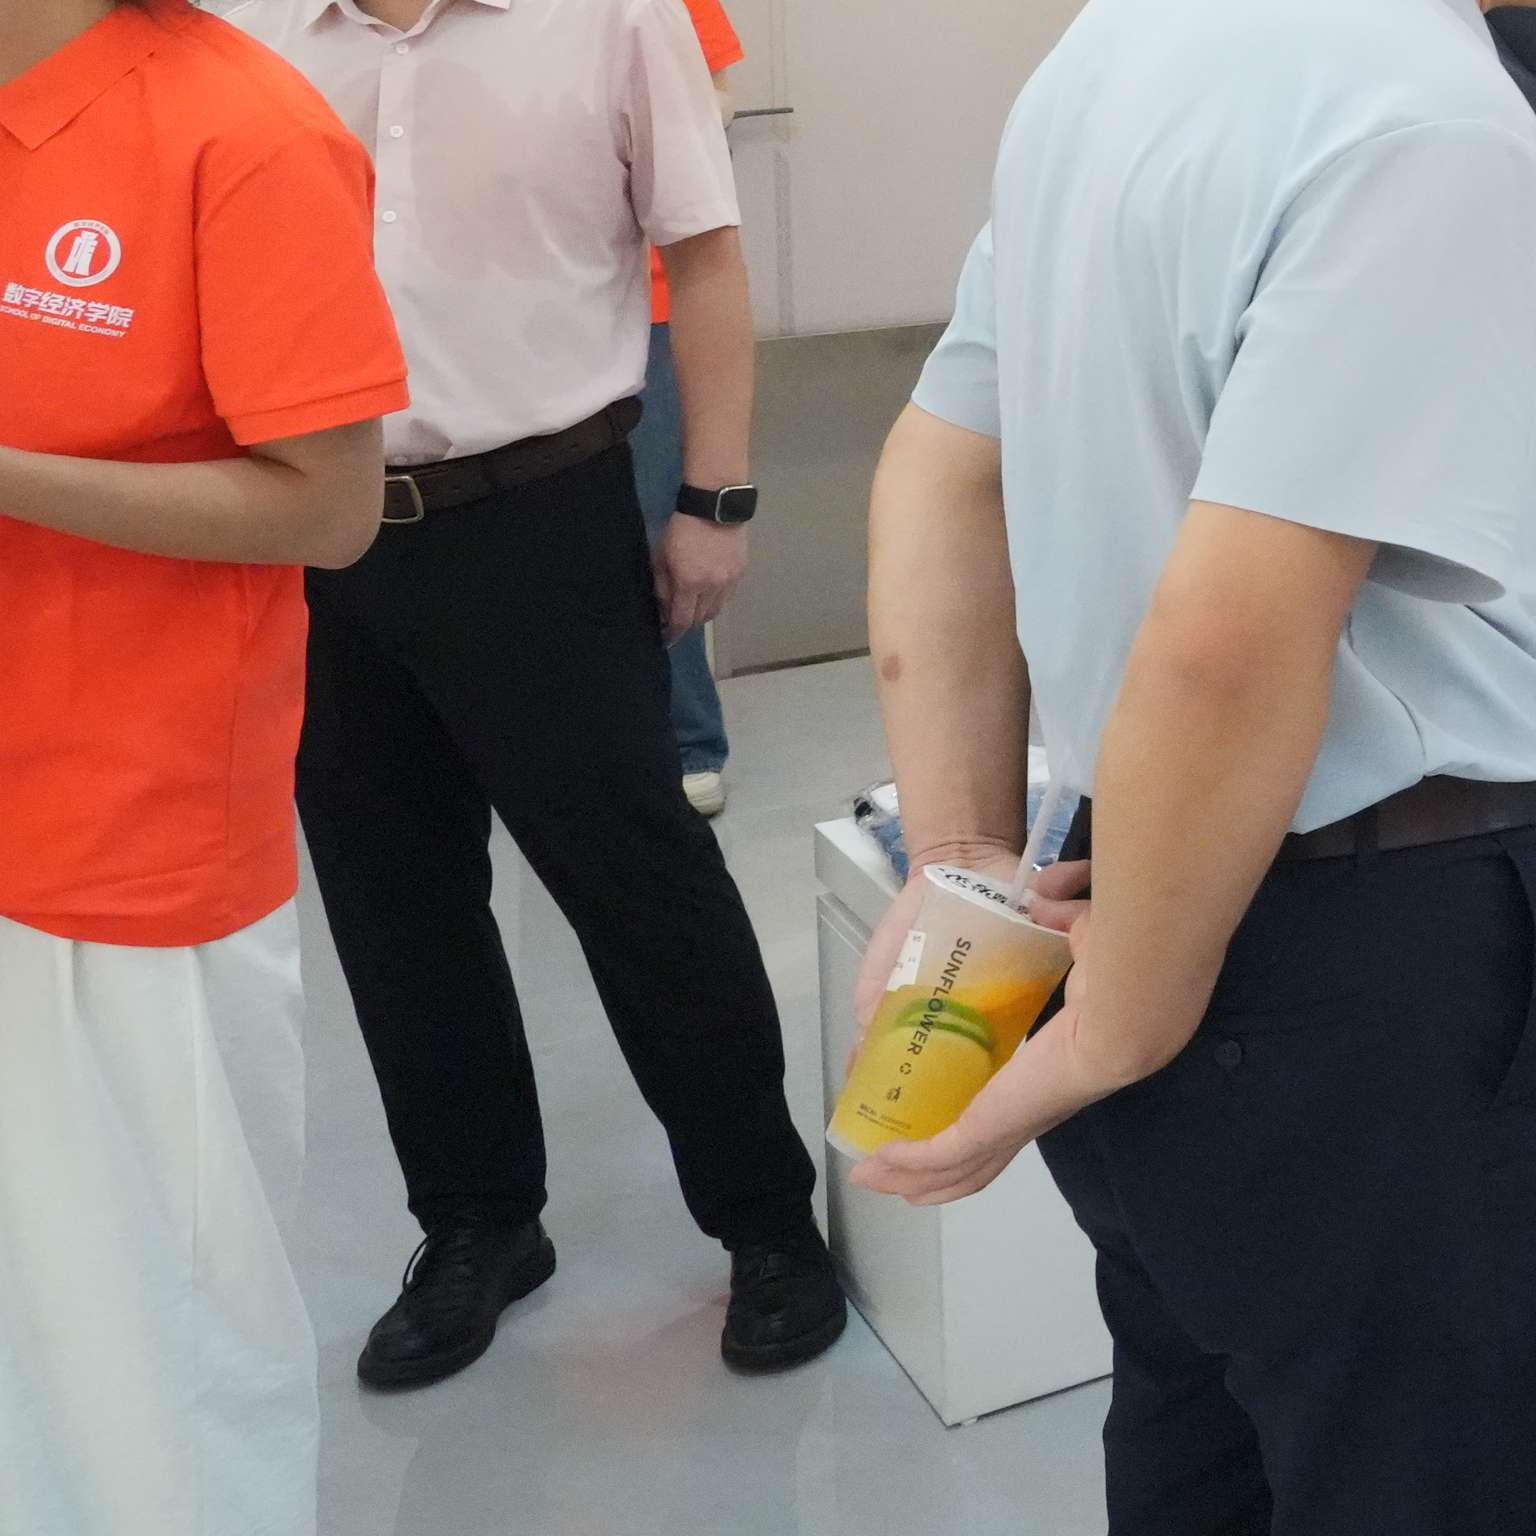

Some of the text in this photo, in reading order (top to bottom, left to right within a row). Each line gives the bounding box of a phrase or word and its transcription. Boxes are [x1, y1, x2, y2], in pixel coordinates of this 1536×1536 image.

[2, 282, 135, 327] 数字经济学院
[42, 315, 77, 329] DIGITAL
[78, 323, 128, 337] ECONOMY
[907, 937, 972, 1056] SUNFLOWER
